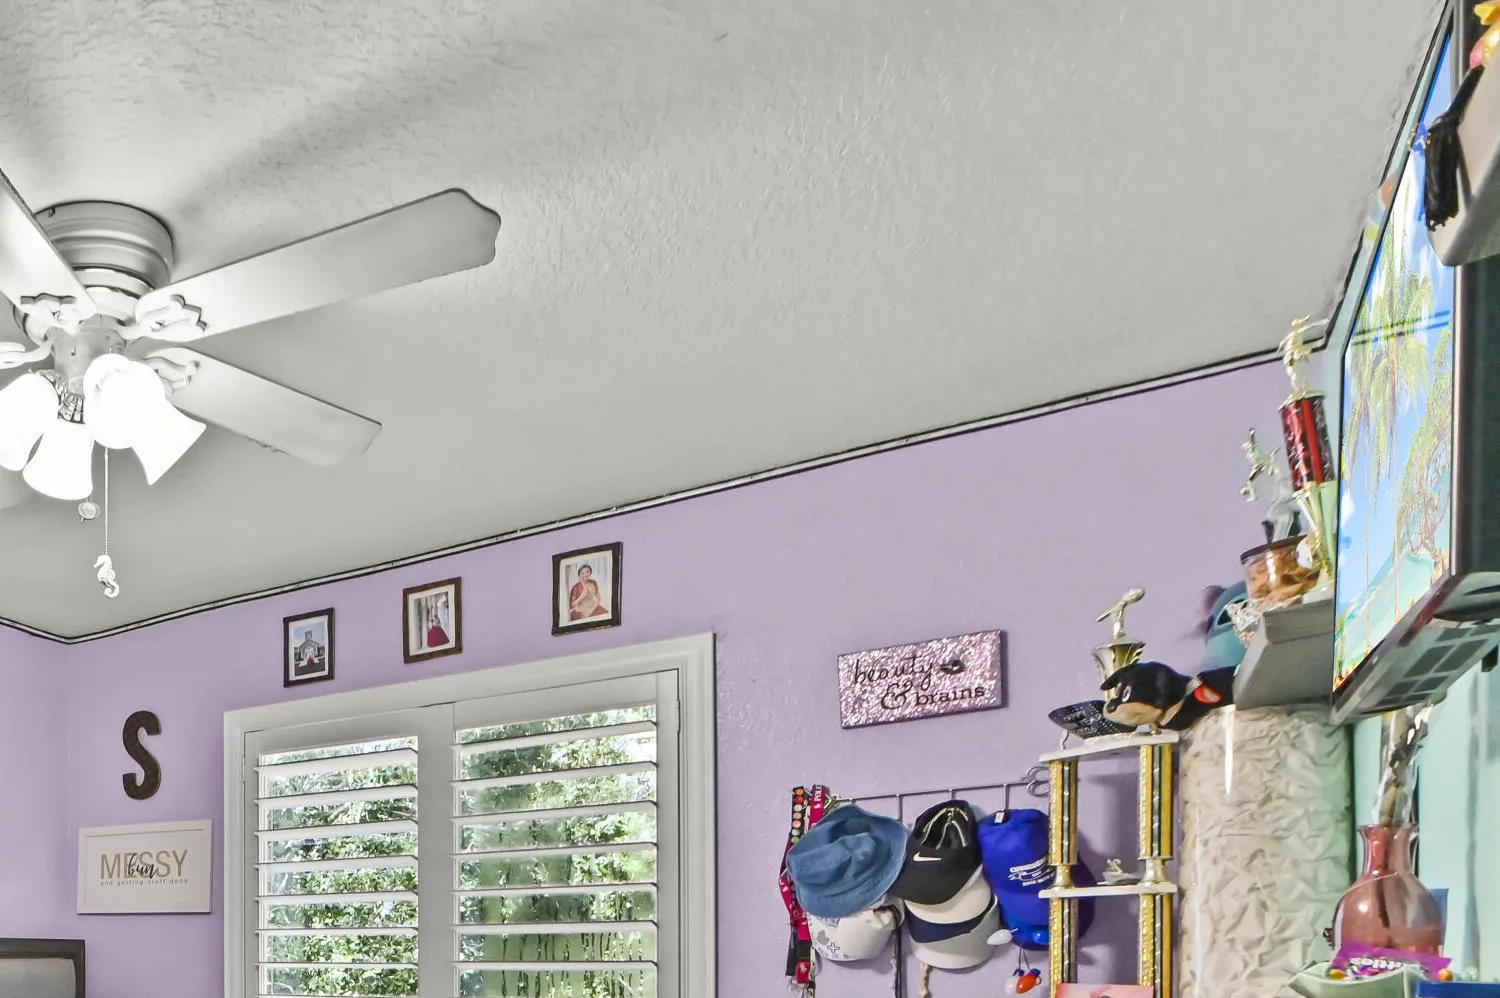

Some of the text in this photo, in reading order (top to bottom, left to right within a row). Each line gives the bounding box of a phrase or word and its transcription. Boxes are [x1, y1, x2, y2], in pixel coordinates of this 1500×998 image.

[854, 655, 933, 690] beauty
[881, 680, 986, 710] & brains
[122, 709, 162, 800] S
[100, 849, 188, 879] MESSY
[127, 852, 158, 879] bun
